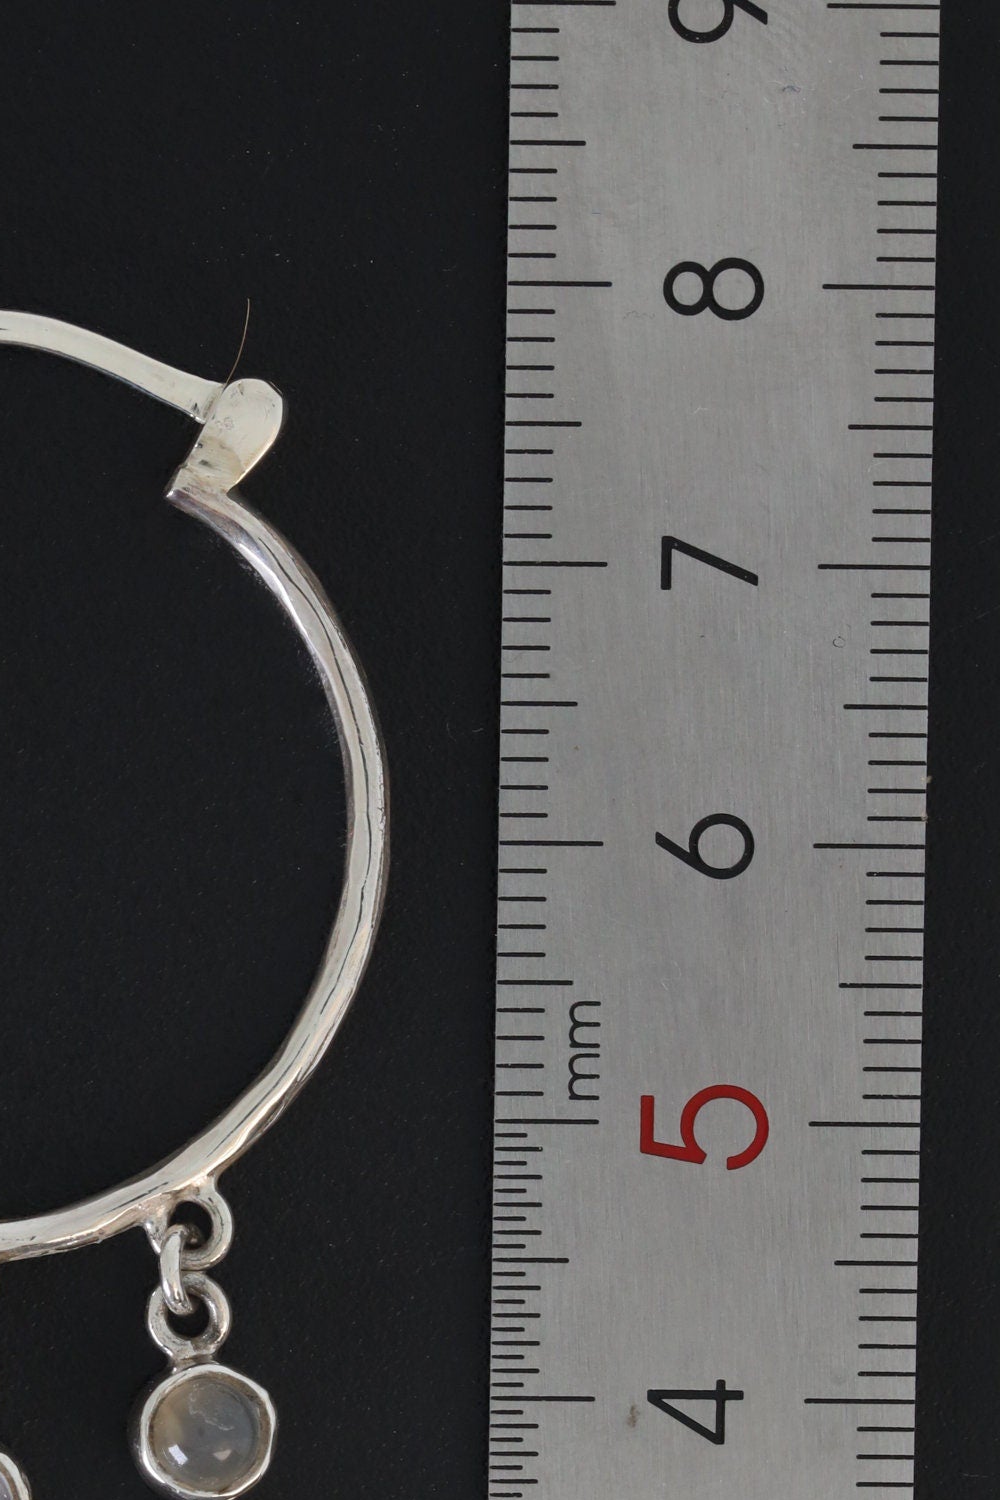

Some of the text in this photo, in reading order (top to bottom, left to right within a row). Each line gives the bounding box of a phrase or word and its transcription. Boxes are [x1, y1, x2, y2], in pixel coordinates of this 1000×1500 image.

[667, 0, 769, 44] 9
[662, 257, 765, 322] 8
[660, 535, 759, 591] 7
[654, 812, 755, 880] 6
[567, 1000, 602, 1101] mm
[639, 1085, 770, 1171] 5
[646, 1379, 745, 1446] 4
